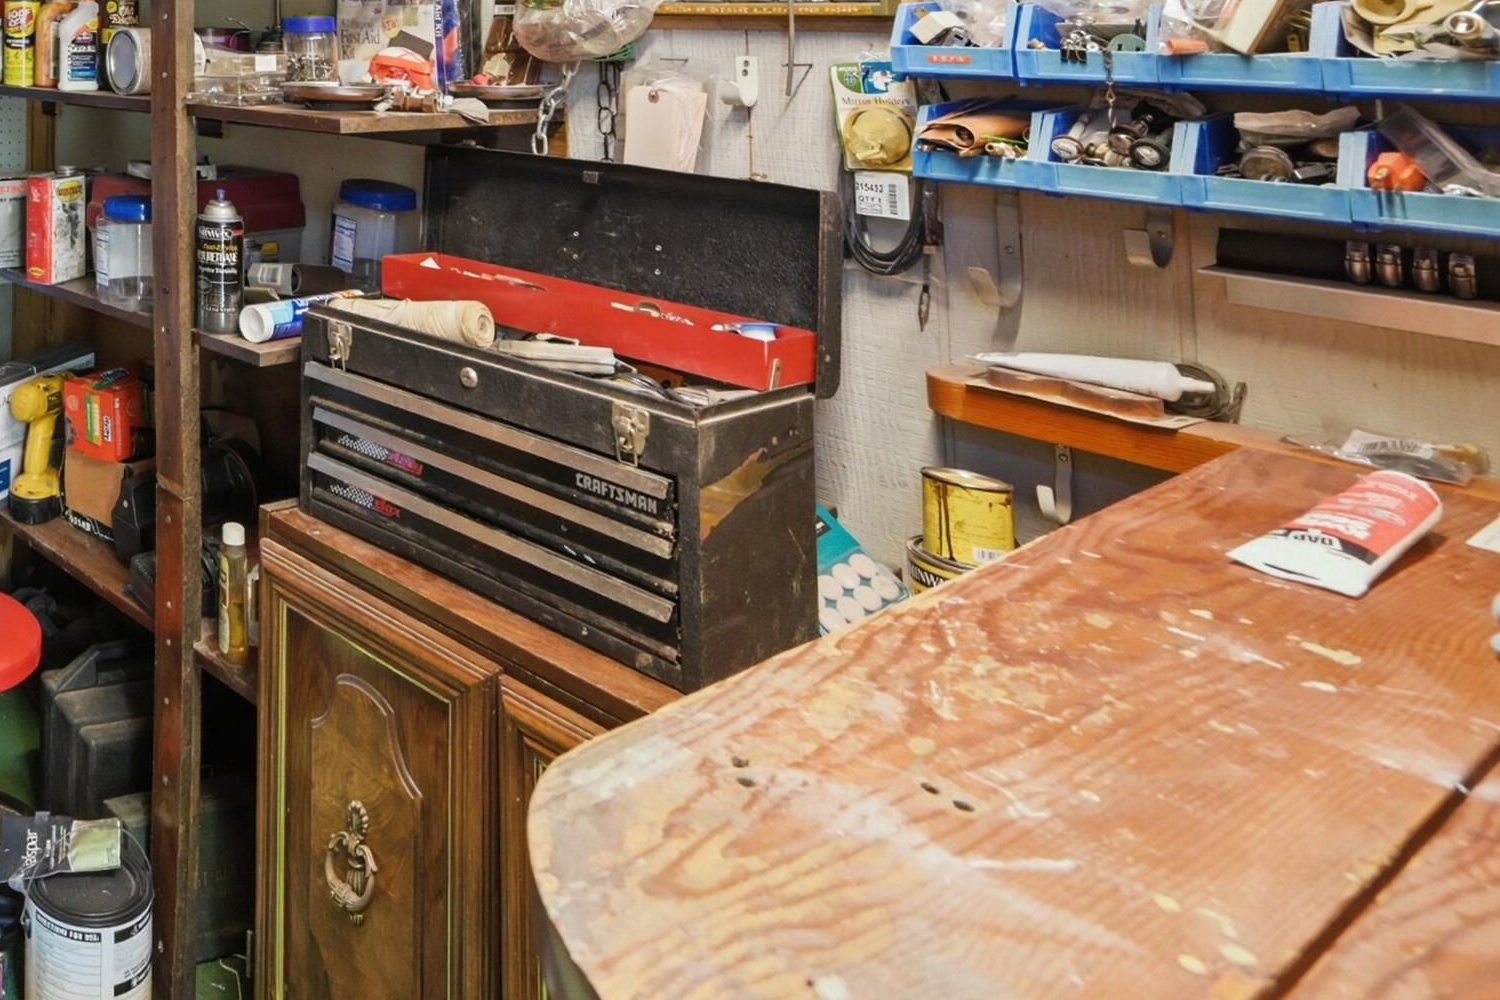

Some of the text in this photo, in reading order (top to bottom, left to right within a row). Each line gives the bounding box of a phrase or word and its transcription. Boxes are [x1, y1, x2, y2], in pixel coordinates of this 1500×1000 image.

[340, 29, 381, 45] First Aid
[841, 96, 913, 106] Mirror Holders
[575, 472, 658, 515] CRAFTSMAN
[1293, 533, 1335, 548] DAP
[20, 828, 42, 868] alspar
